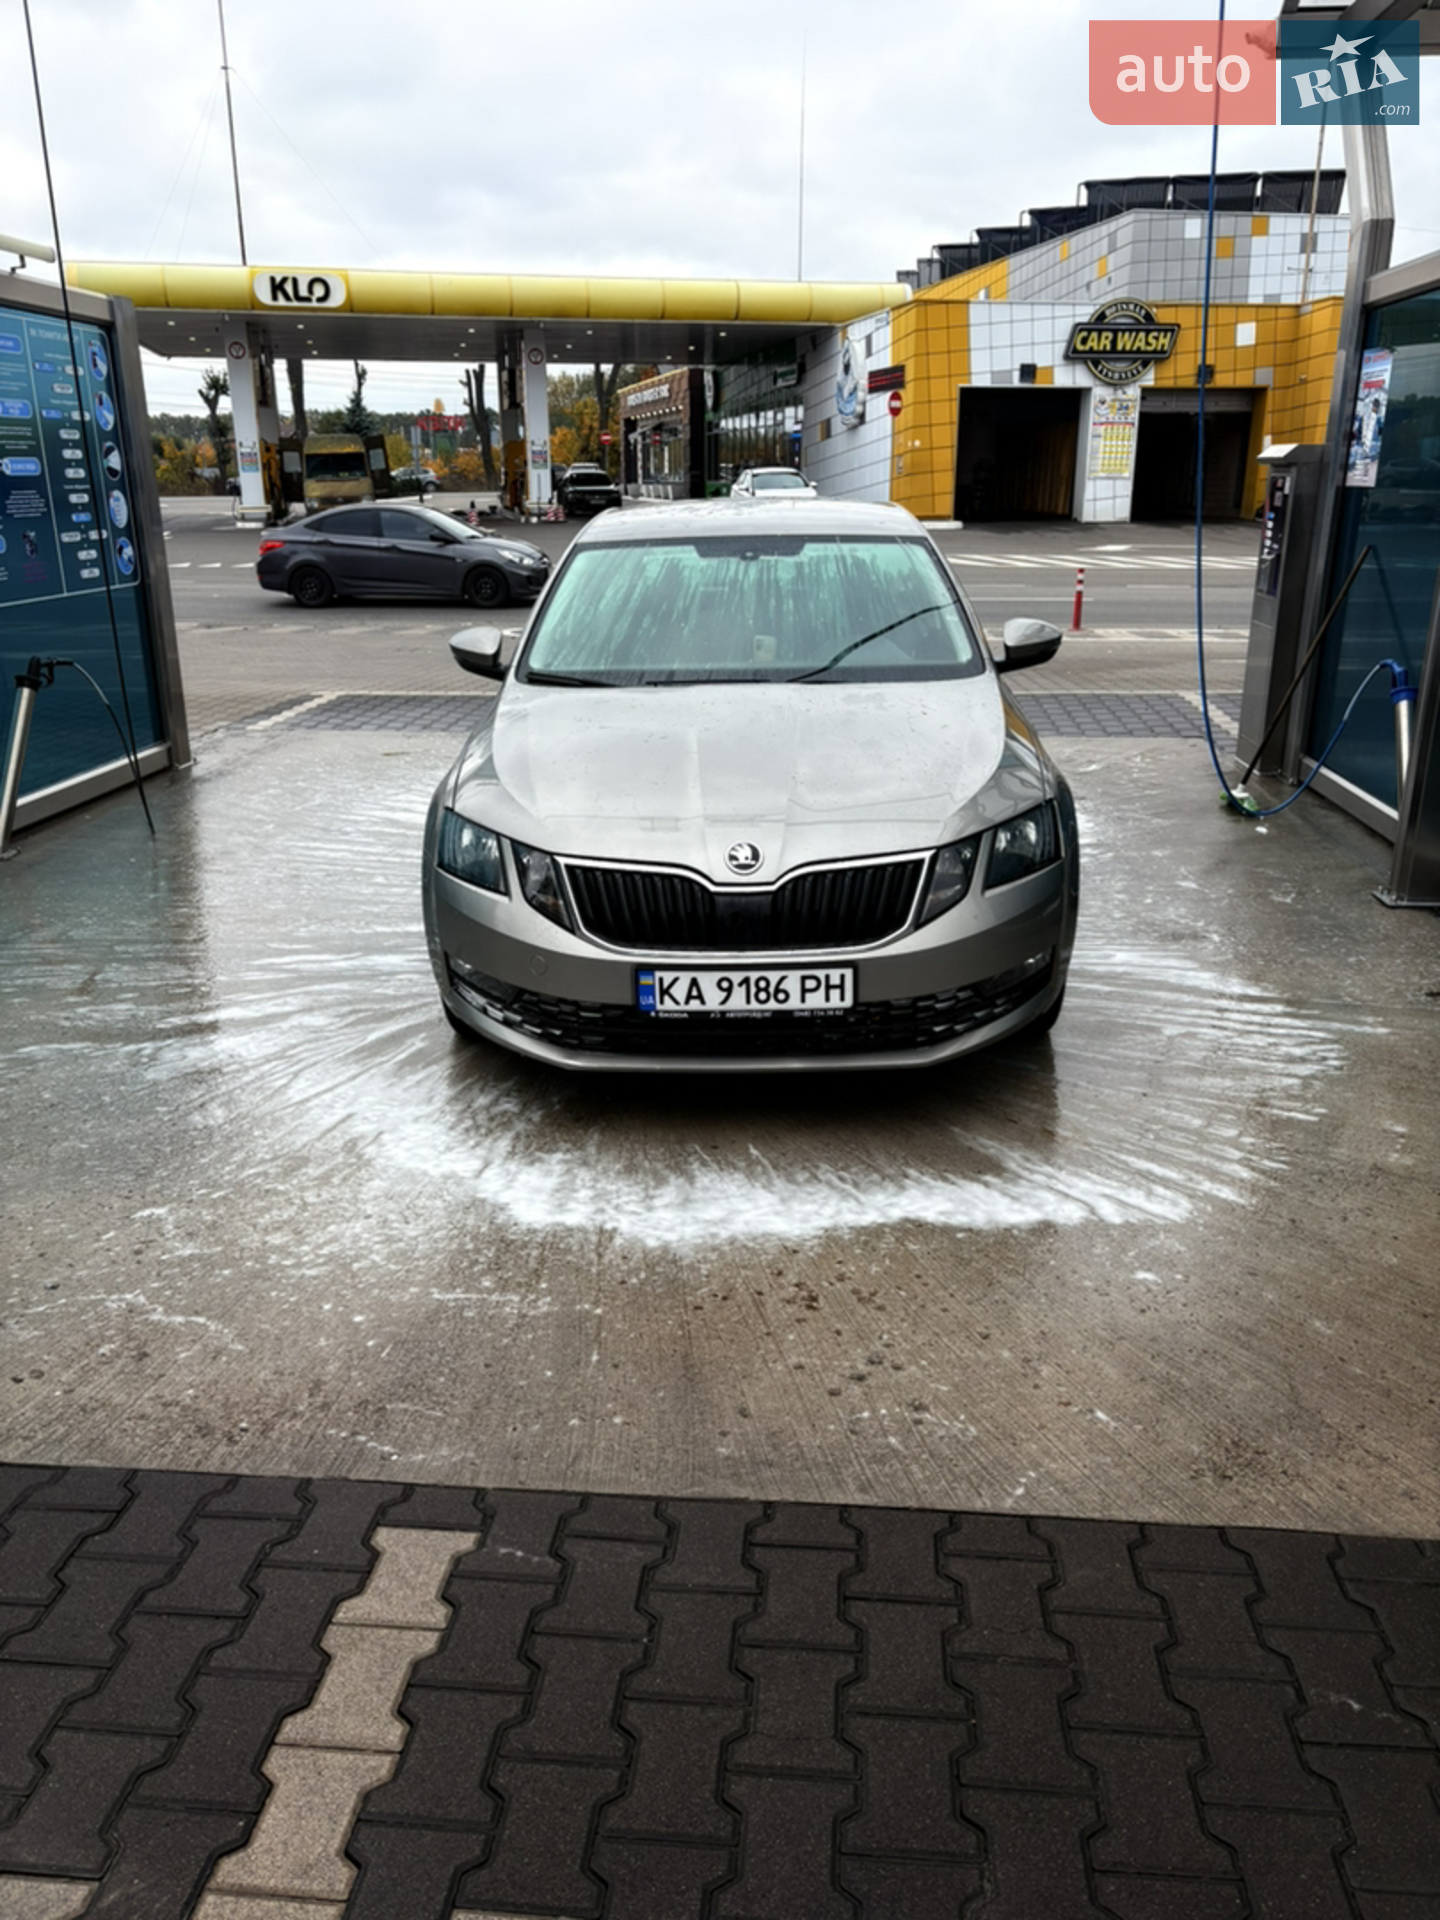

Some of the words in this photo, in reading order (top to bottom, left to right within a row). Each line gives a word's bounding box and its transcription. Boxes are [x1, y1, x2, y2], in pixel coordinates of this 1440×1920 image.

[269, 275, 331, 304] KLO
[1075, 330, 1113, 352] CAR
[1116, 330, 1171, 352] WASH
[640, 995, 655, 1006] UA
[657, 975, 706, 1007] KA
[716, 975, 790, 1006] 9186
[800, 973, 846, 1004] PH
